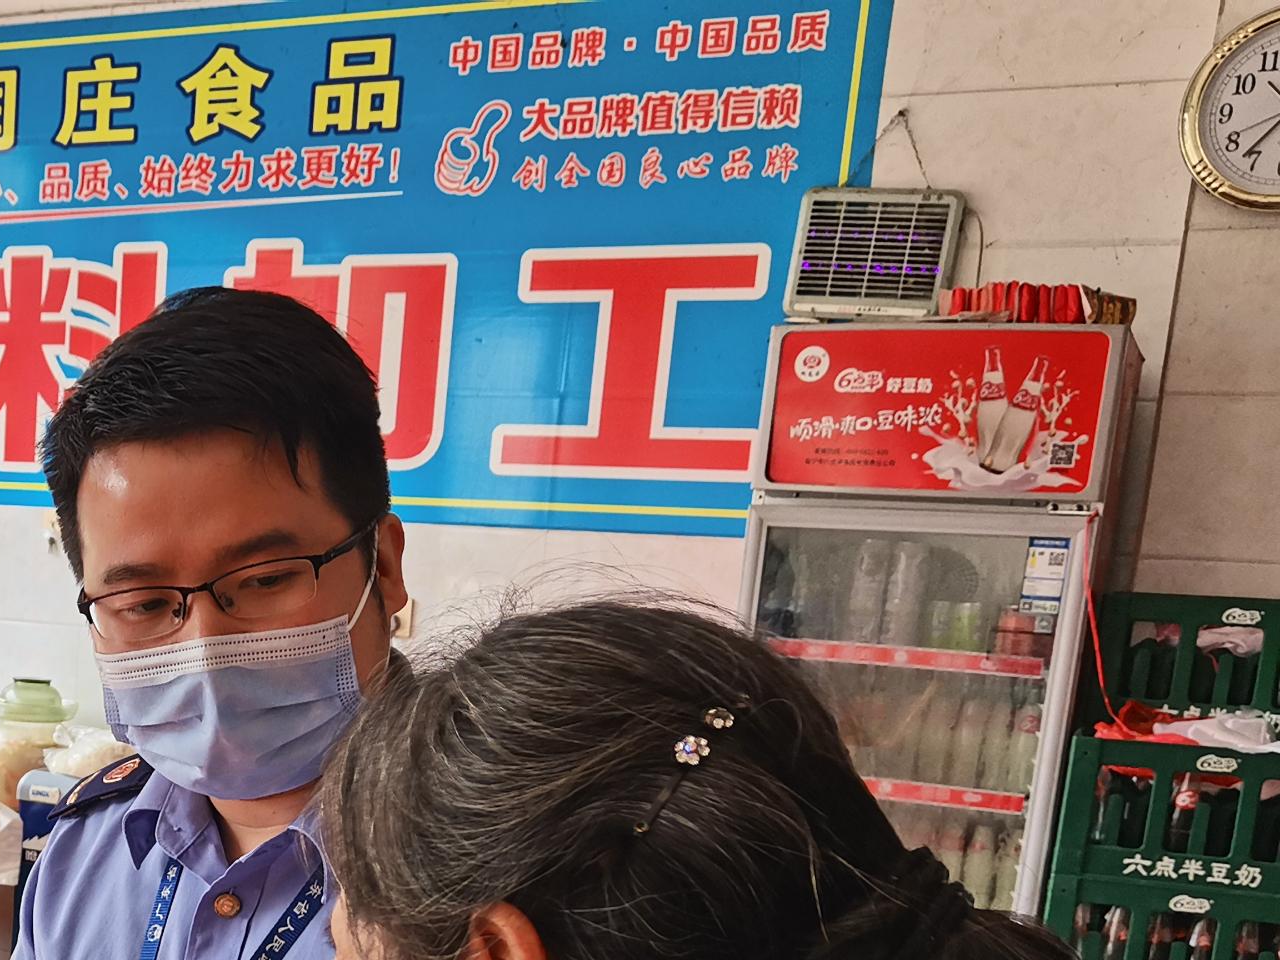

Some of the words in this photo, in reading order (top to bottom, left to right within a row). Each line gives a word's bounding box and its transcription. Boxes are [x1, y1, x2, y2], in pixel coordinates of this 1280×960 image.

[449, 10, 829, 75] 中国品牌·中国品质
[1258, 50, 1279, 72] 11
[1232, 73, 1256, 95] 10
[520, 83, 802, 143] 大品牌值得信赖
[1218, 103, 1233, 124] 9
[1225, 131, 1240, 152] 8
[513, 144, 800, 192] 创全国良心品牌
[1246, 150, 1262, 172] 7
[1123, 854, 1262, 888] 六点半豆奶
